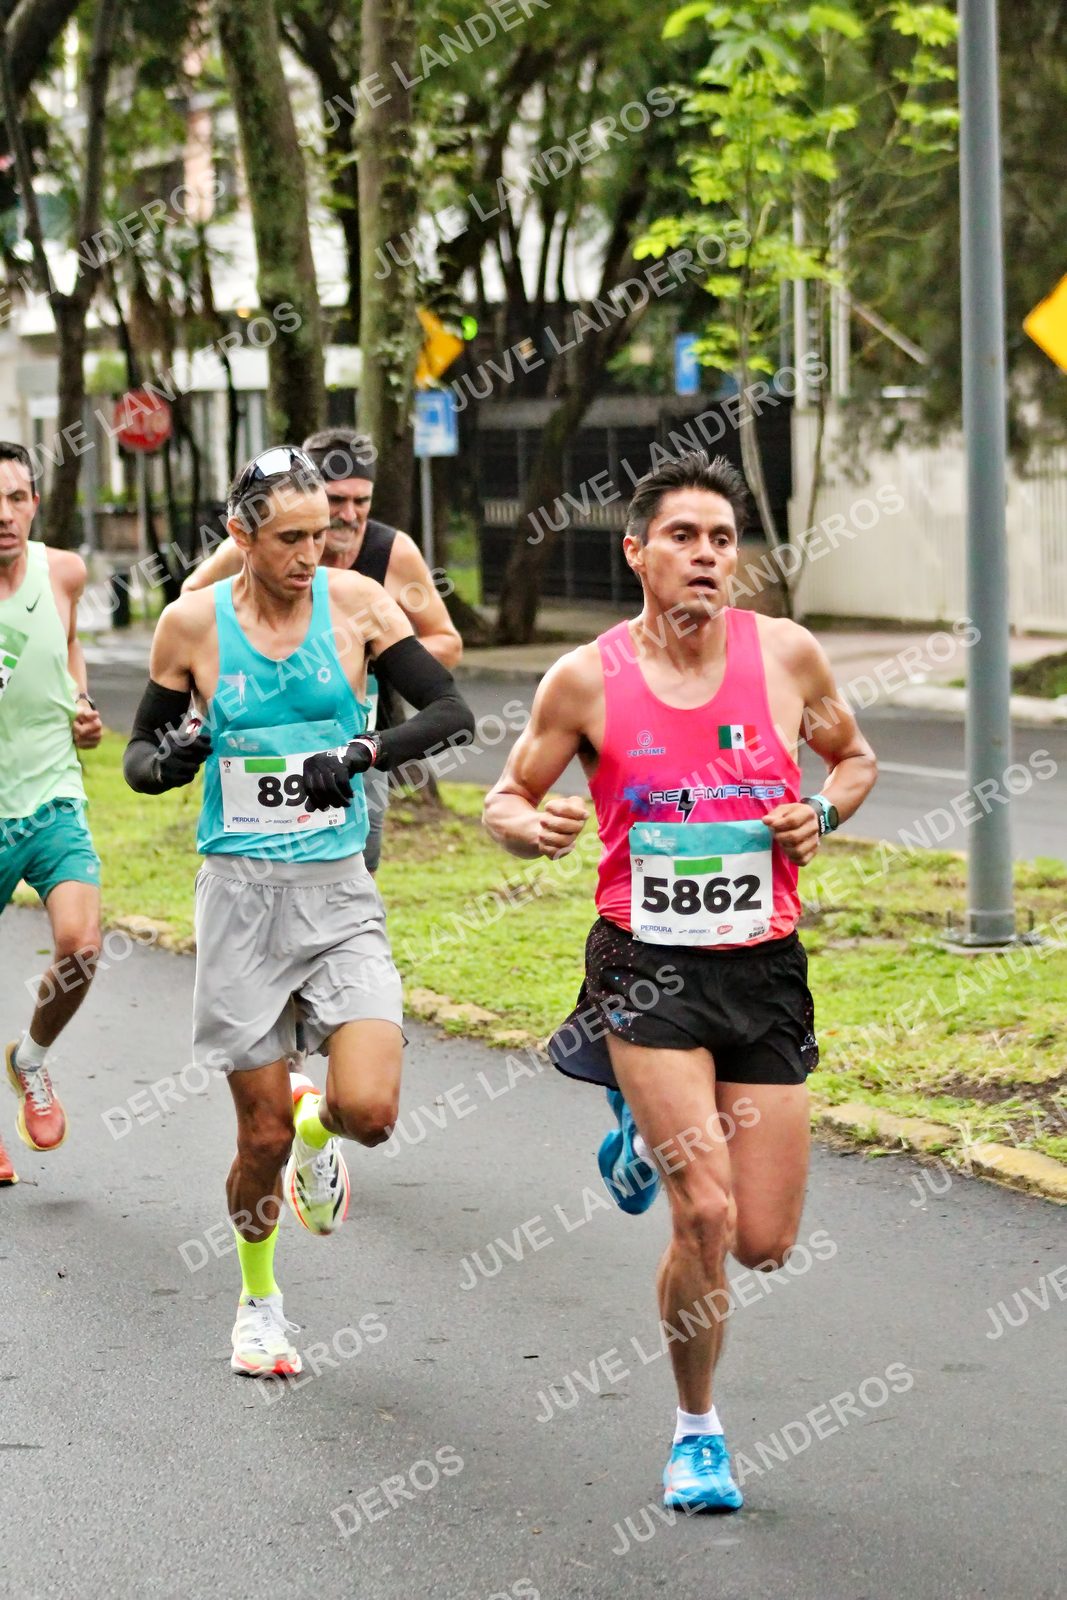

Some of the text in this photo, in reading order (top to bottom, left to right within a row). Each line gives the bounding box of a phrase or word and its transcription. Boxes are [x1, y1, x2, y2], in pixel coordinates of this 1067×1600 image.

[257, 774, 308, 807] 89
[232, 816, 259, 824] PERDURA
[641, 874, 762, 915] 5862
[640, 924, 672, 934] PERDURA
